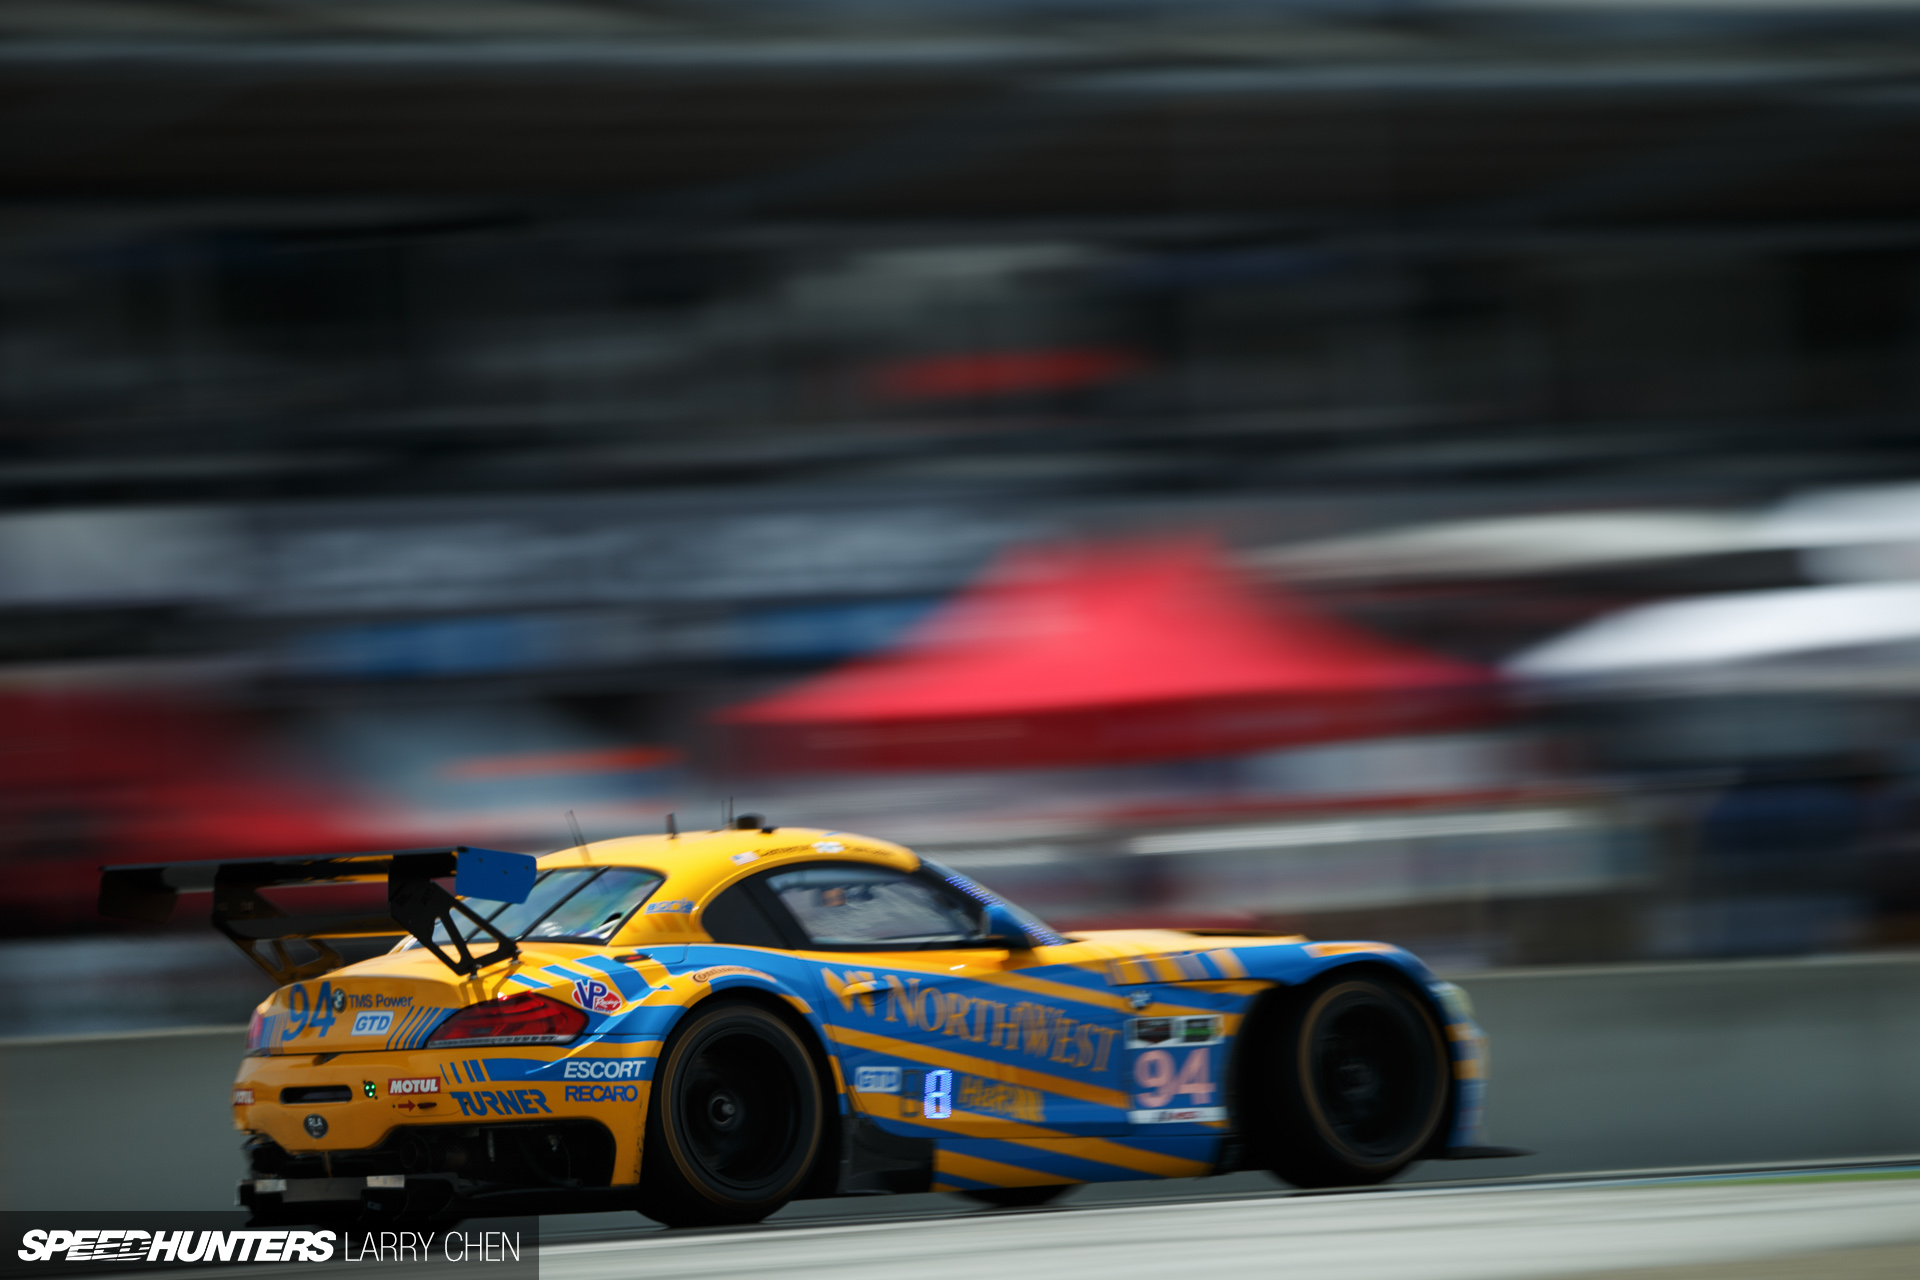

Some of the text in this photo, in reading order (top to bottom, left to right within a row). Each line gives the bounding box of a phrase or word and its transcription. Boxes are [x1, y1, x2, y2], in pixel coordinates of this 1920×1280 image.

[349, 993, 414, 1009] TMS Power
[576, 980, 608, 1011] VP
[281, 980, 336, 1042] 94
[355, 1010, 391, 1032] GTD
[884, 975, 1122, 1072] NORTHWEST
[563, 1060, 647, 1079] ESCORT
[1133, 1047, 1217, 1108] 94
[389, 1078, 438, 1094] MOTUL
[565, 1085, 638, 1102] RECARO
[449, 1088, 553, 1116] TURNER
